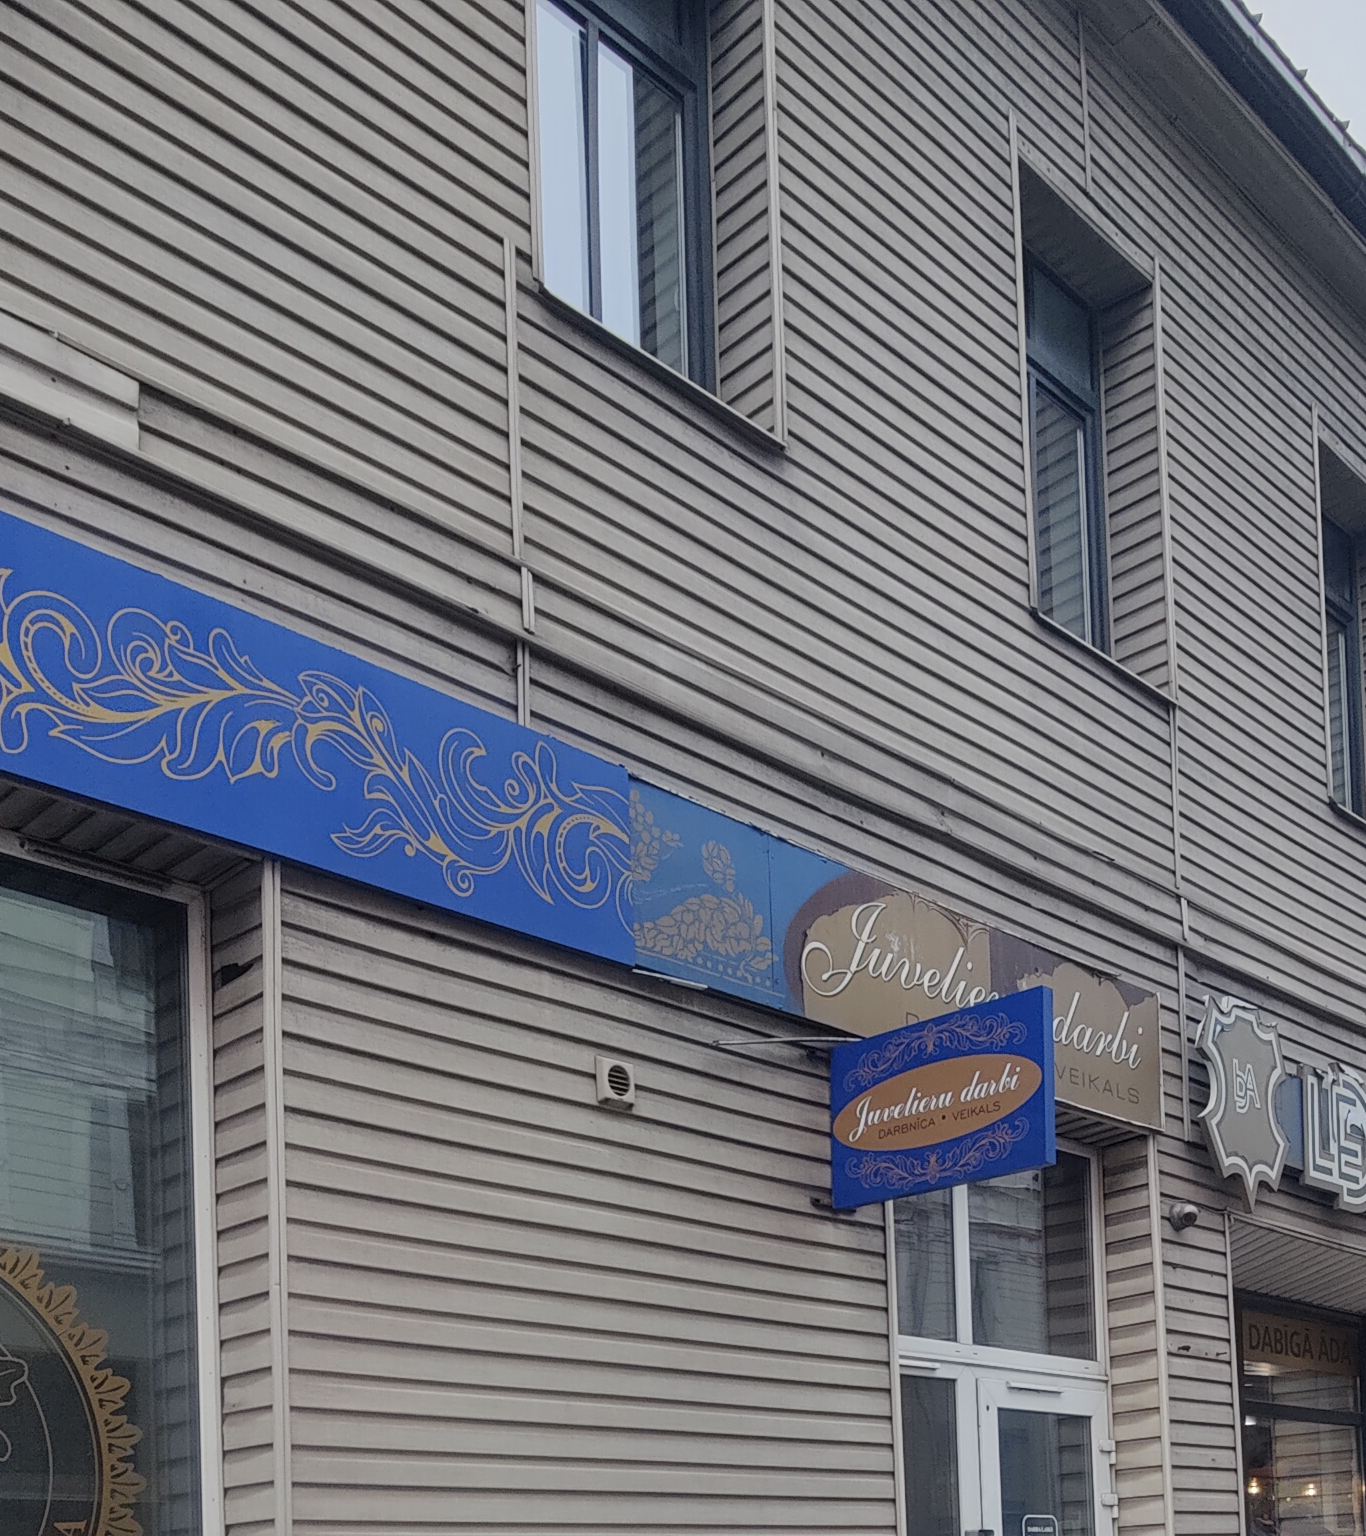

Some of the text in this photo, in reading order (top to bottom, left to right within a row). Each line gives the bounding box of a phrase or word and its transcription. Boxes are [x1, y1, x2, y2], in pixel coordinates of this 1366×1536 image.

[801, 902, 1143, 1070] Juvelie darbi
[848, 1062, 1021, 1143] Juvelieru darbi
[1053, 1063, 1141, 1105] VEIKALS
[877, 1100, 1001, 1140] DARBNĪCA VEIKALS
[1247, 1322, 1314, 1360] DABĪGĀ
